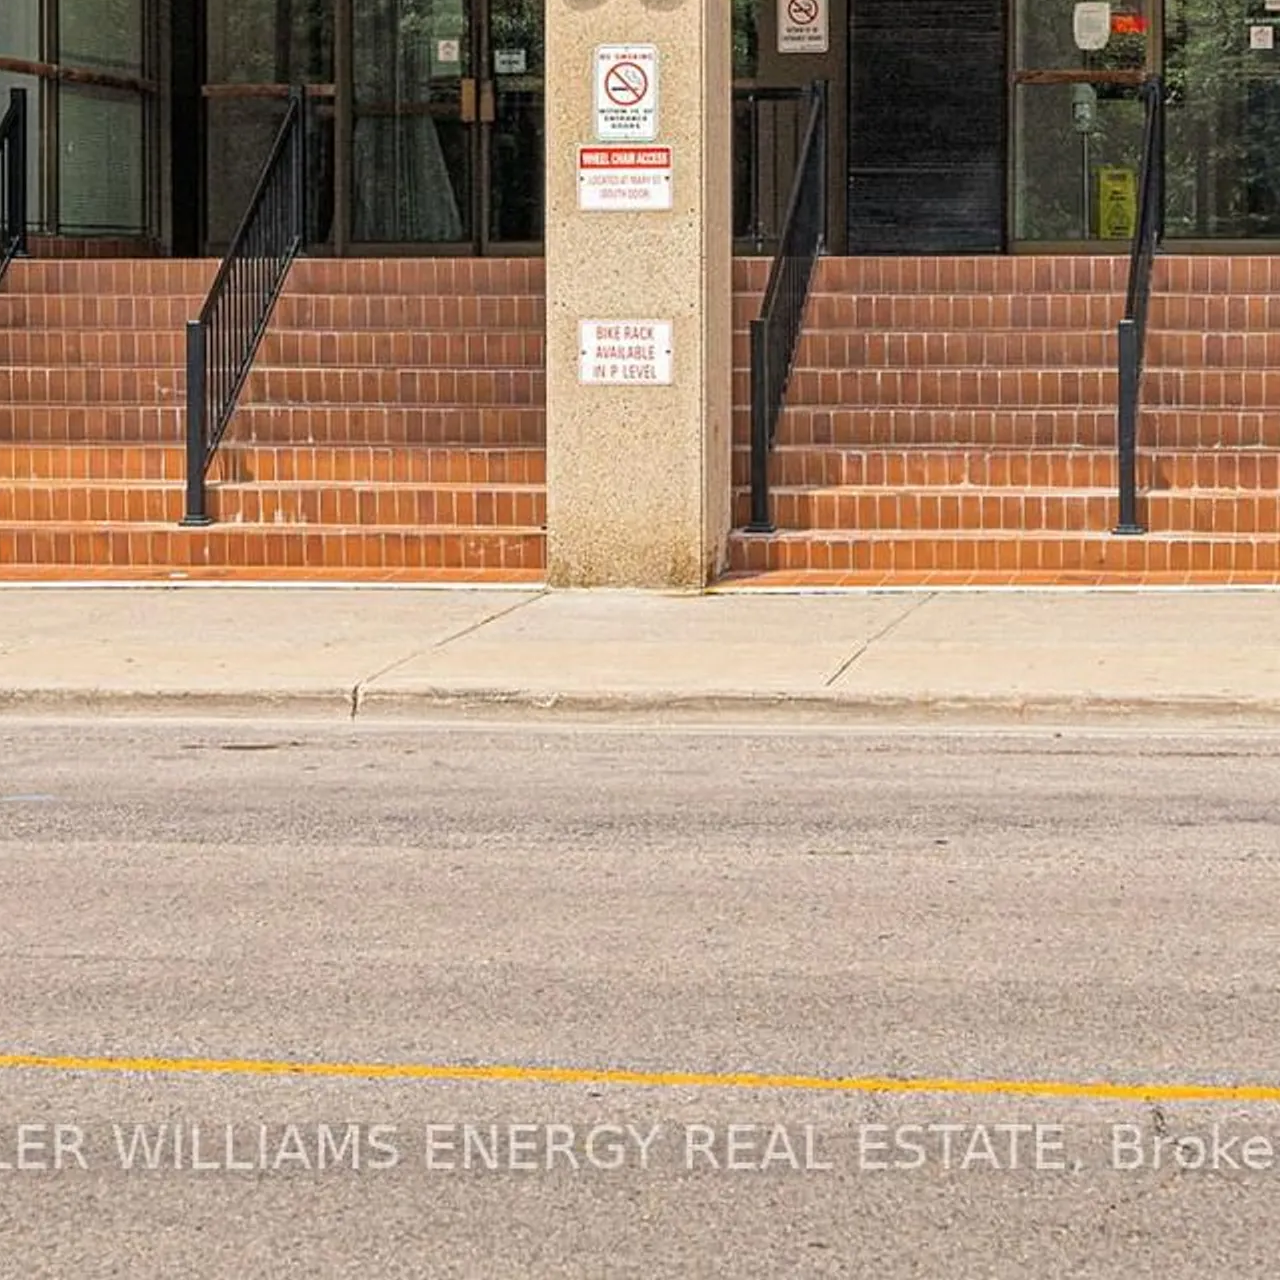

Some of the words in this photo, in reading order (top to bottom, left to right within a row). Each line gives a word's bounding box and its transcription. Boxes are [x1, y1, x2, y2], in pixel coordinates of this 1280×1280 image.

[596, 326, 621, 340] BIKE
[624, 326, 655, 340] RACK
[596, 345, 655, 360] AVAILABLE
[593, 364, 606, 378] IN
[610, 364, 618, 378] P
[623, 364, 657, 379] LEVEL
